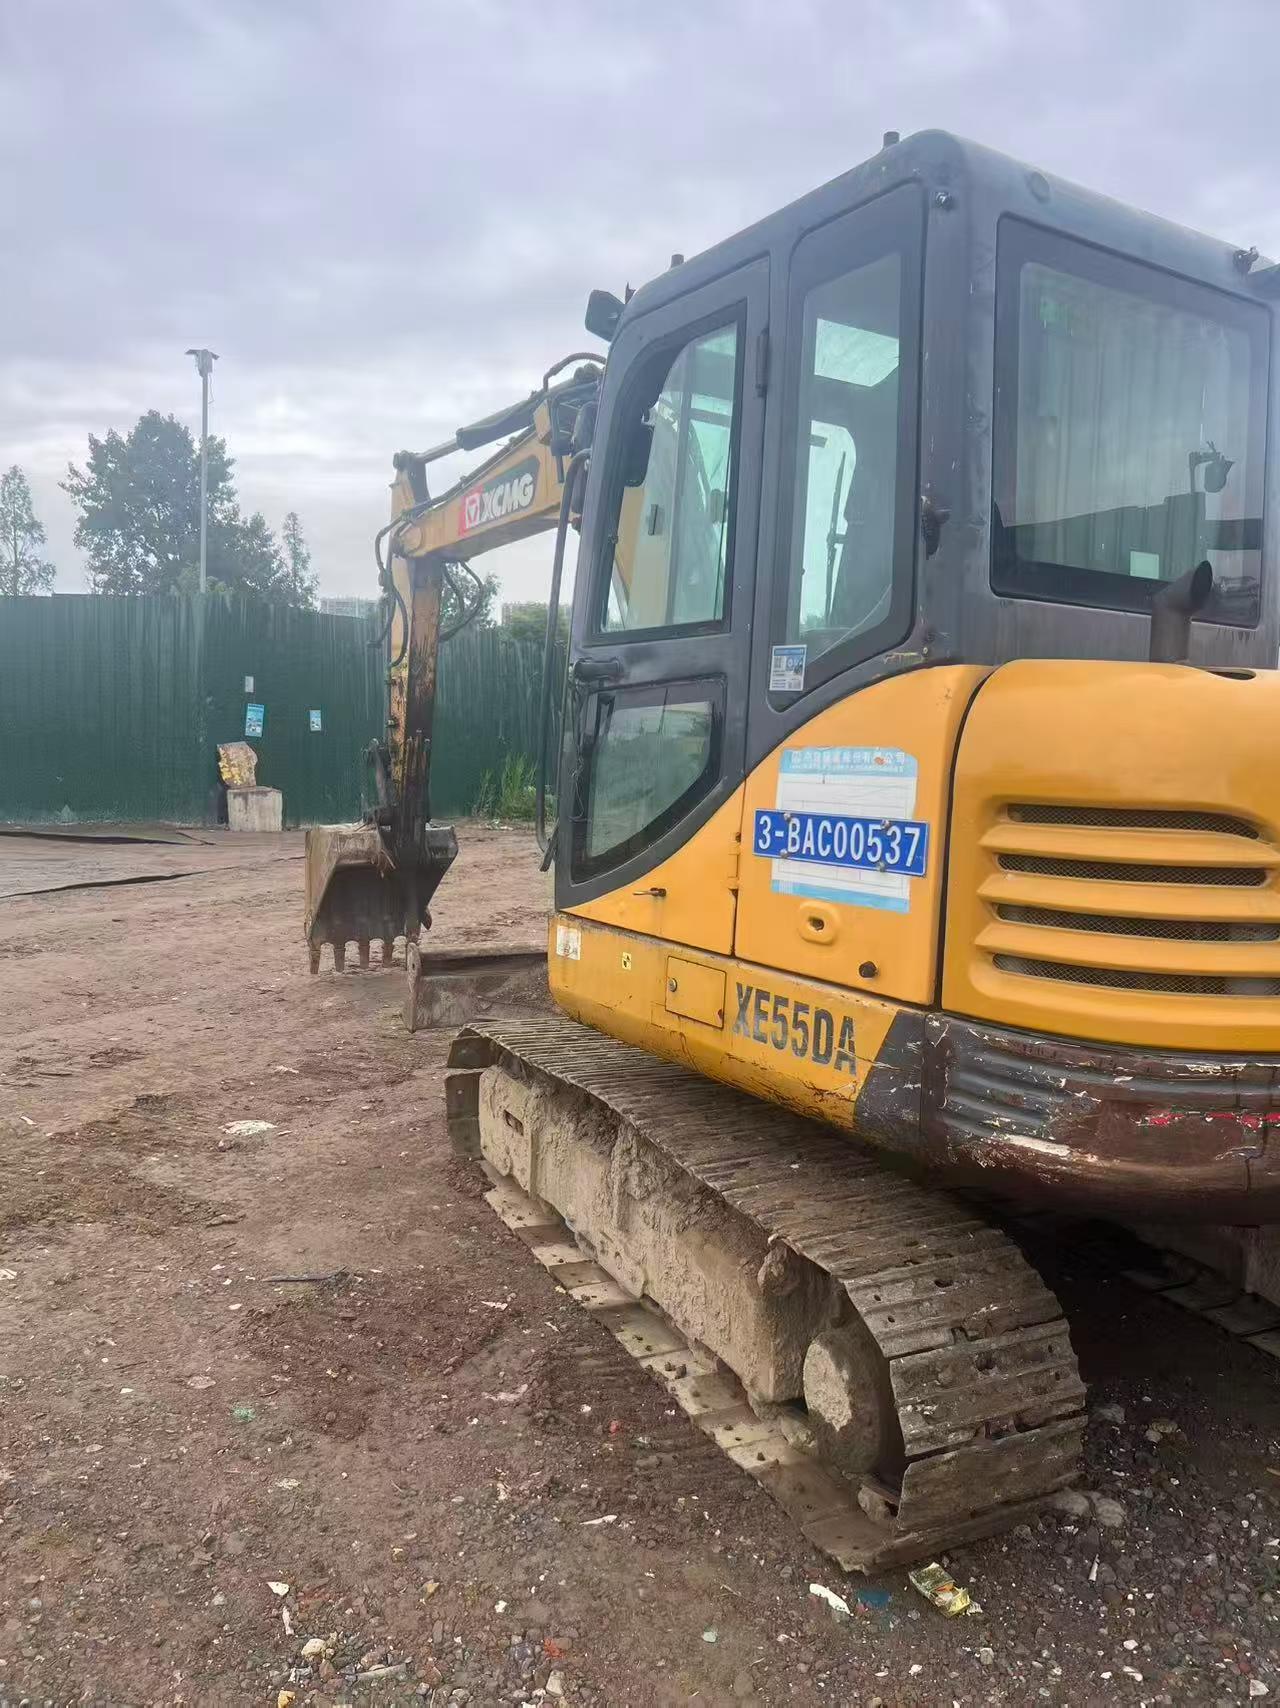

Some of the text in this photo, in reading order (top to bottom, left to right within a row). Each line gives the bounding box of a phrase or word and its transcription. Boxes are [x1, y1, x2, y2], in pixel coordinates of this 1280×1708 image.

[480, 473, 534, 521] XCMG
[758, 815, 921, 867] 3-BAC00537
[732, 982, 857, 1077] XE55DA
